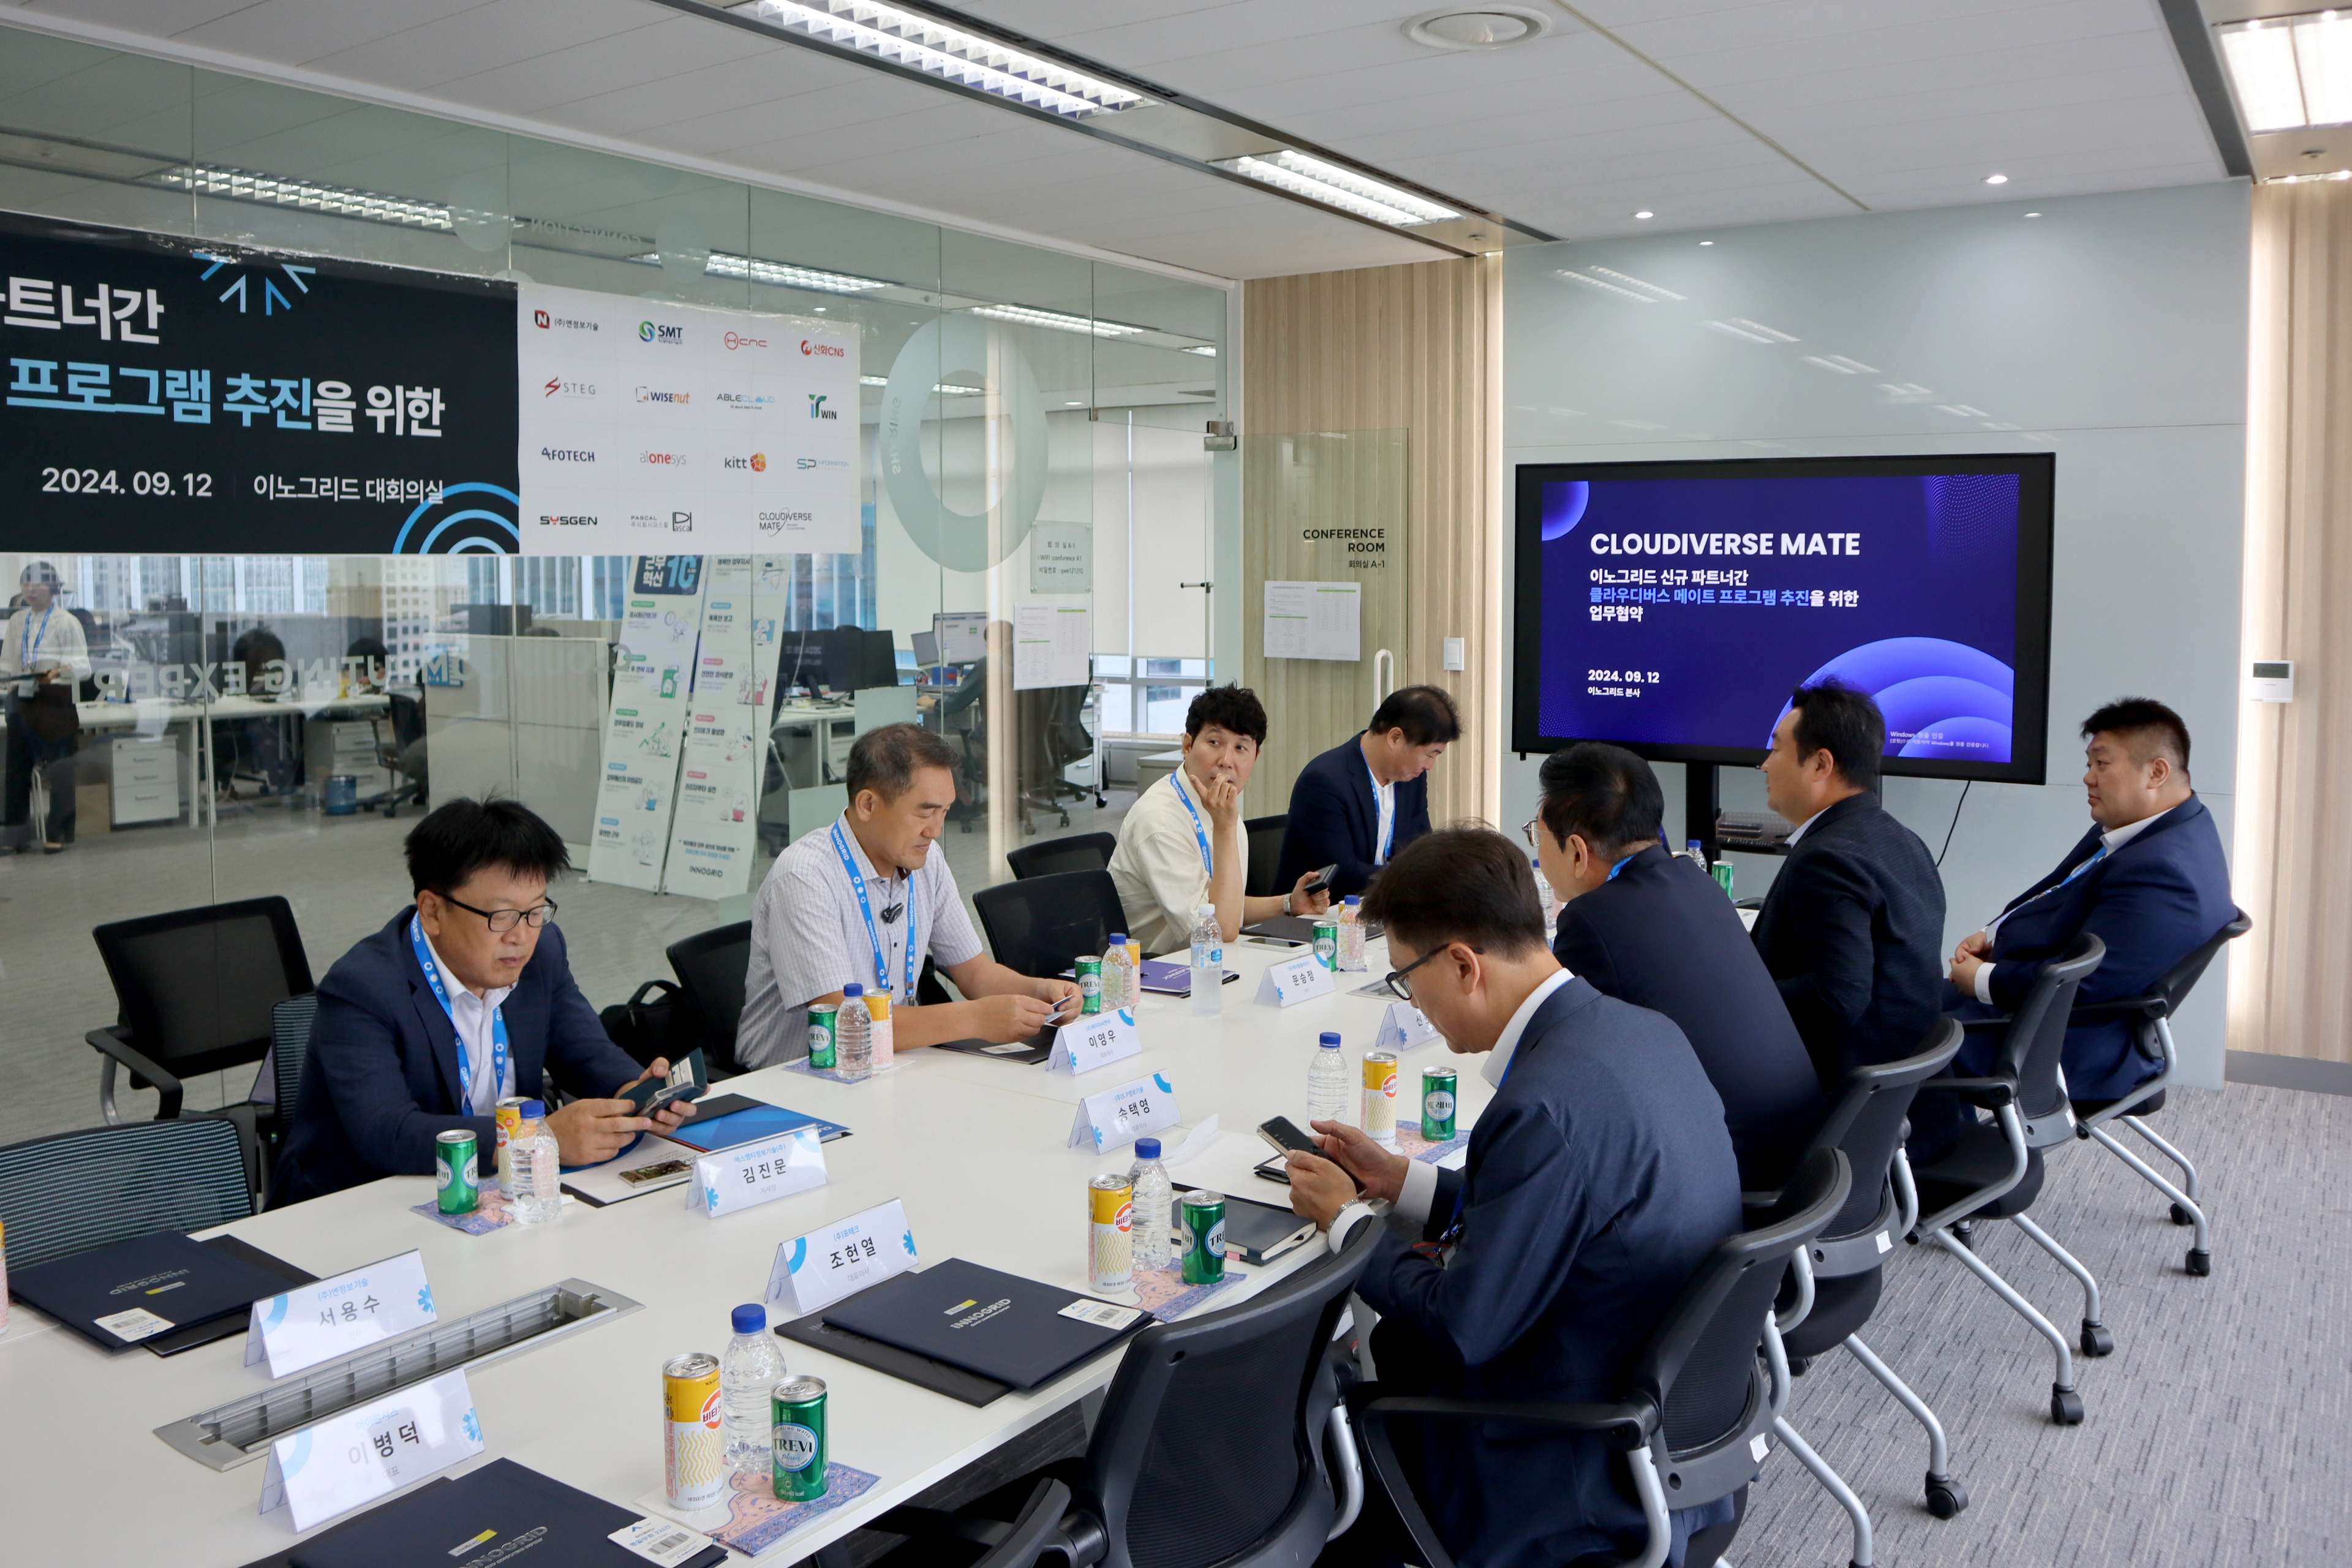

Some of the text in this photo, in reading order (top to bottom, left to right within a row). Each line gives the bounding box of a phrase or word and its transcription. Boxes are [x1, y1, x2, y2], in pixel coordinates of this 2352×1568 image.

[0, 276, 164, 344] 트너간
[554, 318, 598, 331] (주)엔정보기술
[658, 325, 683, 338] SMT
[813, 344, 844, 357] 신화CNS
[564, 382, 596, 394] STEG
[6, 357, 445, 437] 프로그램 추진을 위한
[650, 391, 690, 404] WISEnut
[821, 410, 837, 420] WIN
[725, 456, 747, 469] kitt
[797, 458, 816, 469] SP
[41, 467, 213, 497] 2024. 09. 12
[253, 473, 444, 505] 이노그리드 대회의실
[540, 516, 597, 525] SYSGEN
[760, 522, 781, 530] MATE
[1303, 529, 1385, 539] CONFERENCE
[1348, 543, 1385, 552] ROOM
[1590, 533, 1860, 556] CLOUDIVERSE MATE
[643, 571, 664, 587] 혁신
[1589, 568, 1749, 586] 이노그리드 신규 파트너간
[1589, 587, 1859, 608] 클라우디버스 메이트 프로그램 추진을 위한
[1589, 605, 1643, 622] 업무협약
[1588, 669, 1659, 684] 2024. 09. 12
[1588, 686, 1640, 698] 이노그리드 본사
[832, 828, 850, 861] INNOGRID
[689, 865, 723, 878] INNOGRID
[1089, 1030, 1116, 1048] 이영우
[1118, 1098, 1150, 1121] 송택영
[742, 1158, 786, 1184] 김진문
[834, 1225, 860, 1242] (주)포테크
[830, 1237, 876, 1269] 조헌열
[318, 1278, 368, 1301] (주)엔정보기술
[320, 1295, 380, 1327] 서용수
[951, 1299, 1011, 1329] INNOGRID
[349, 1421, 420, 1465] 이병덕
[774, 1438, 812, 1453] TREVI
